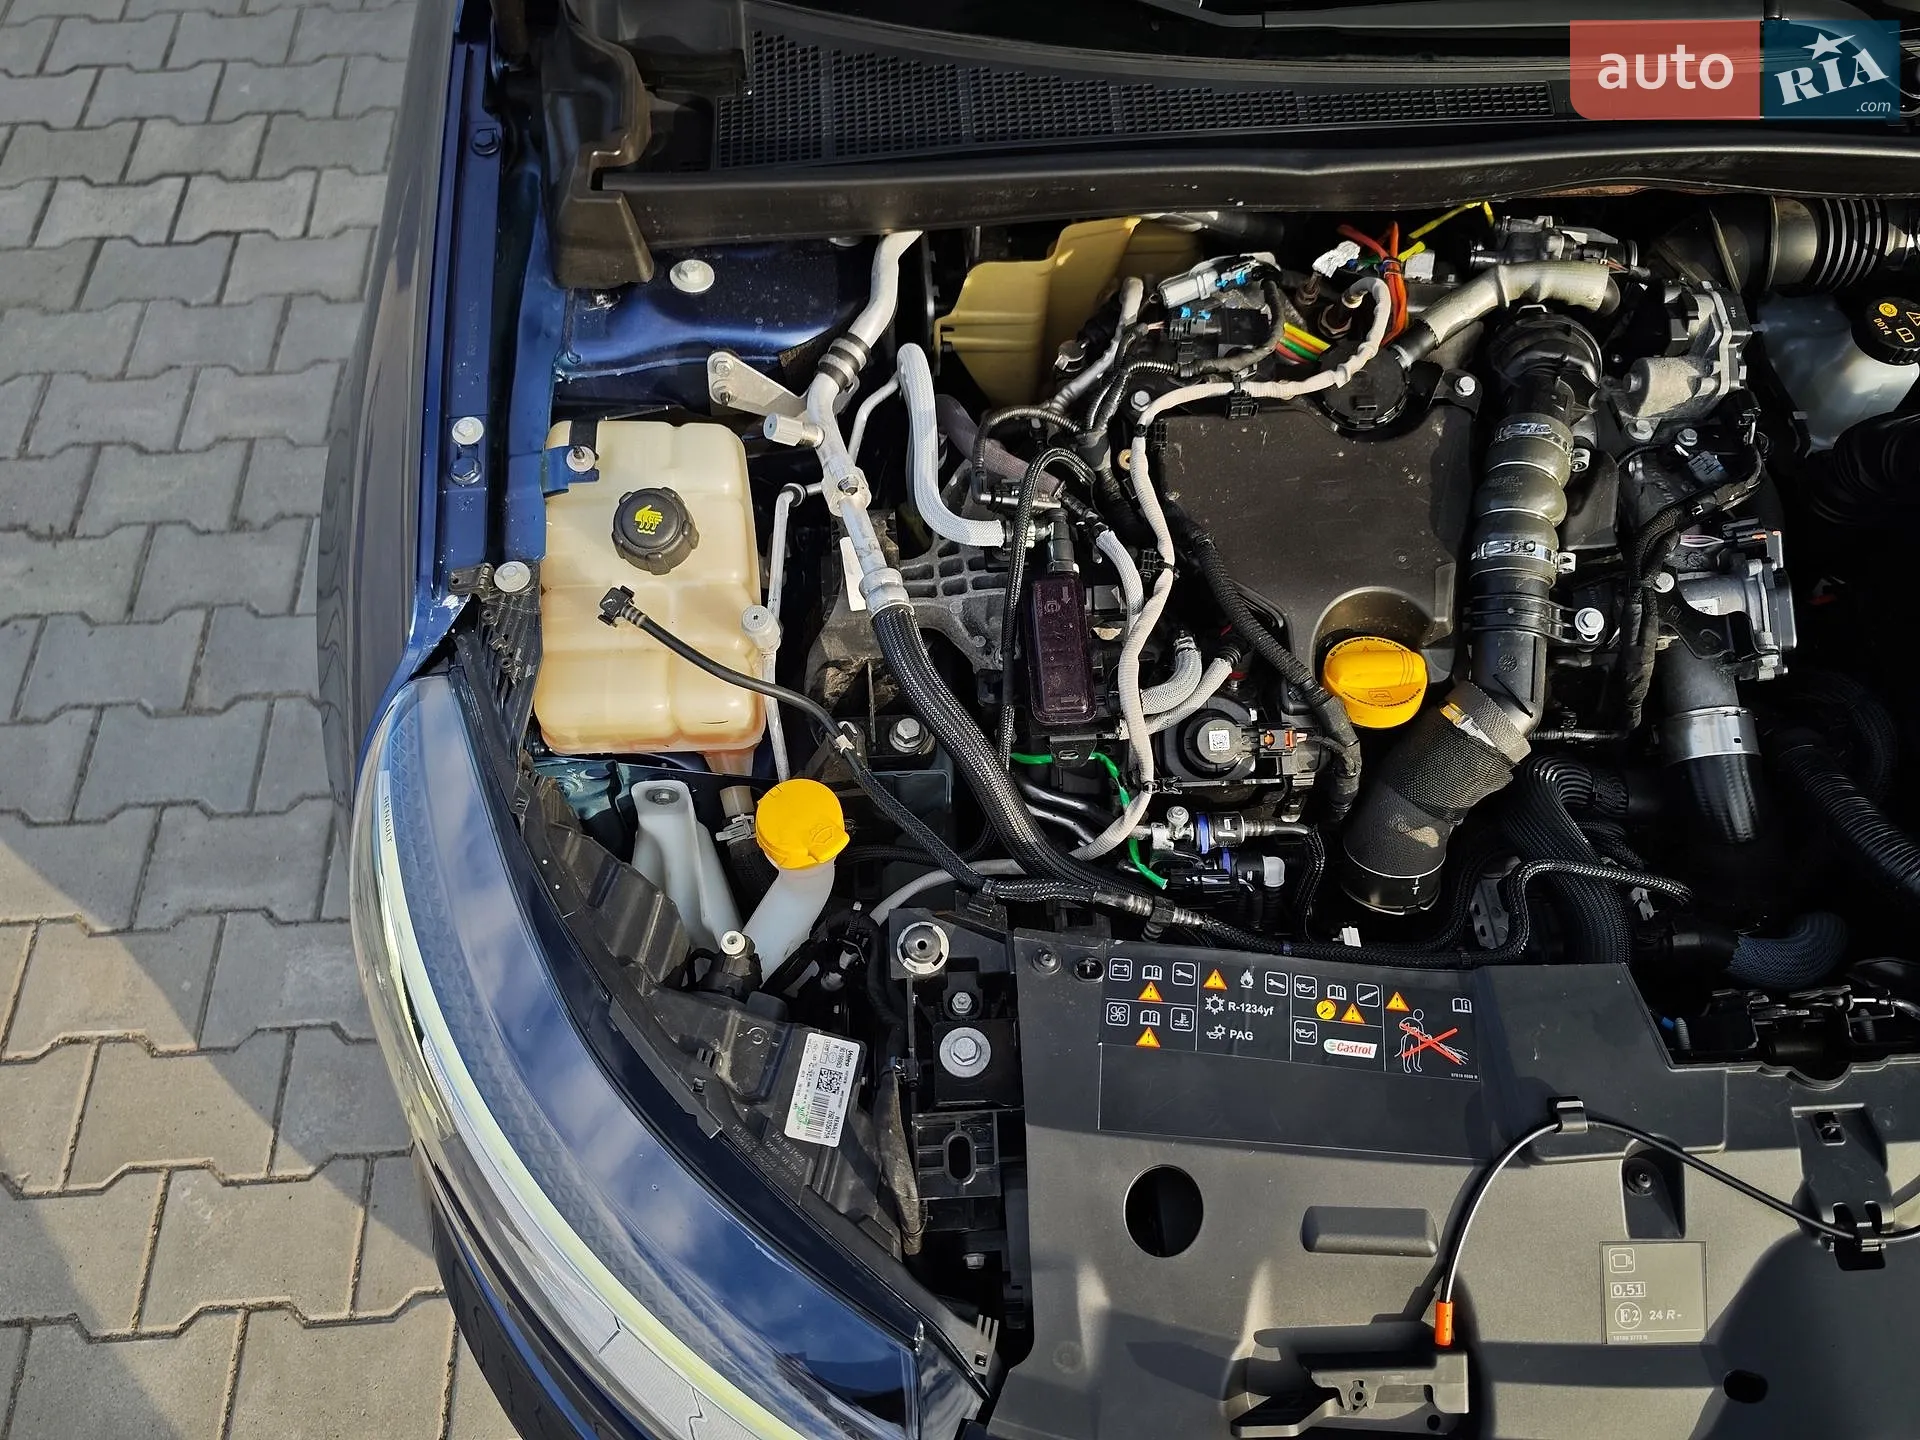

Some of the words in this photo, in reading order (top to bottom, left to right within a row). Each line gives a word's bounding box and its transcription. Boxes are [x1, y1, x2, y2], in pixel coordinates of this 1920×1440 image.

[1228, 1001, 1274, 1016] R-1234yf
[1229, 1029, 1254, 1041] PAG
[1336, 1042, 1373, 1056] Castrol
[1613, 1284, 1643, 1297] 0,51
[1649, 1310, 1663, 1320] 24
